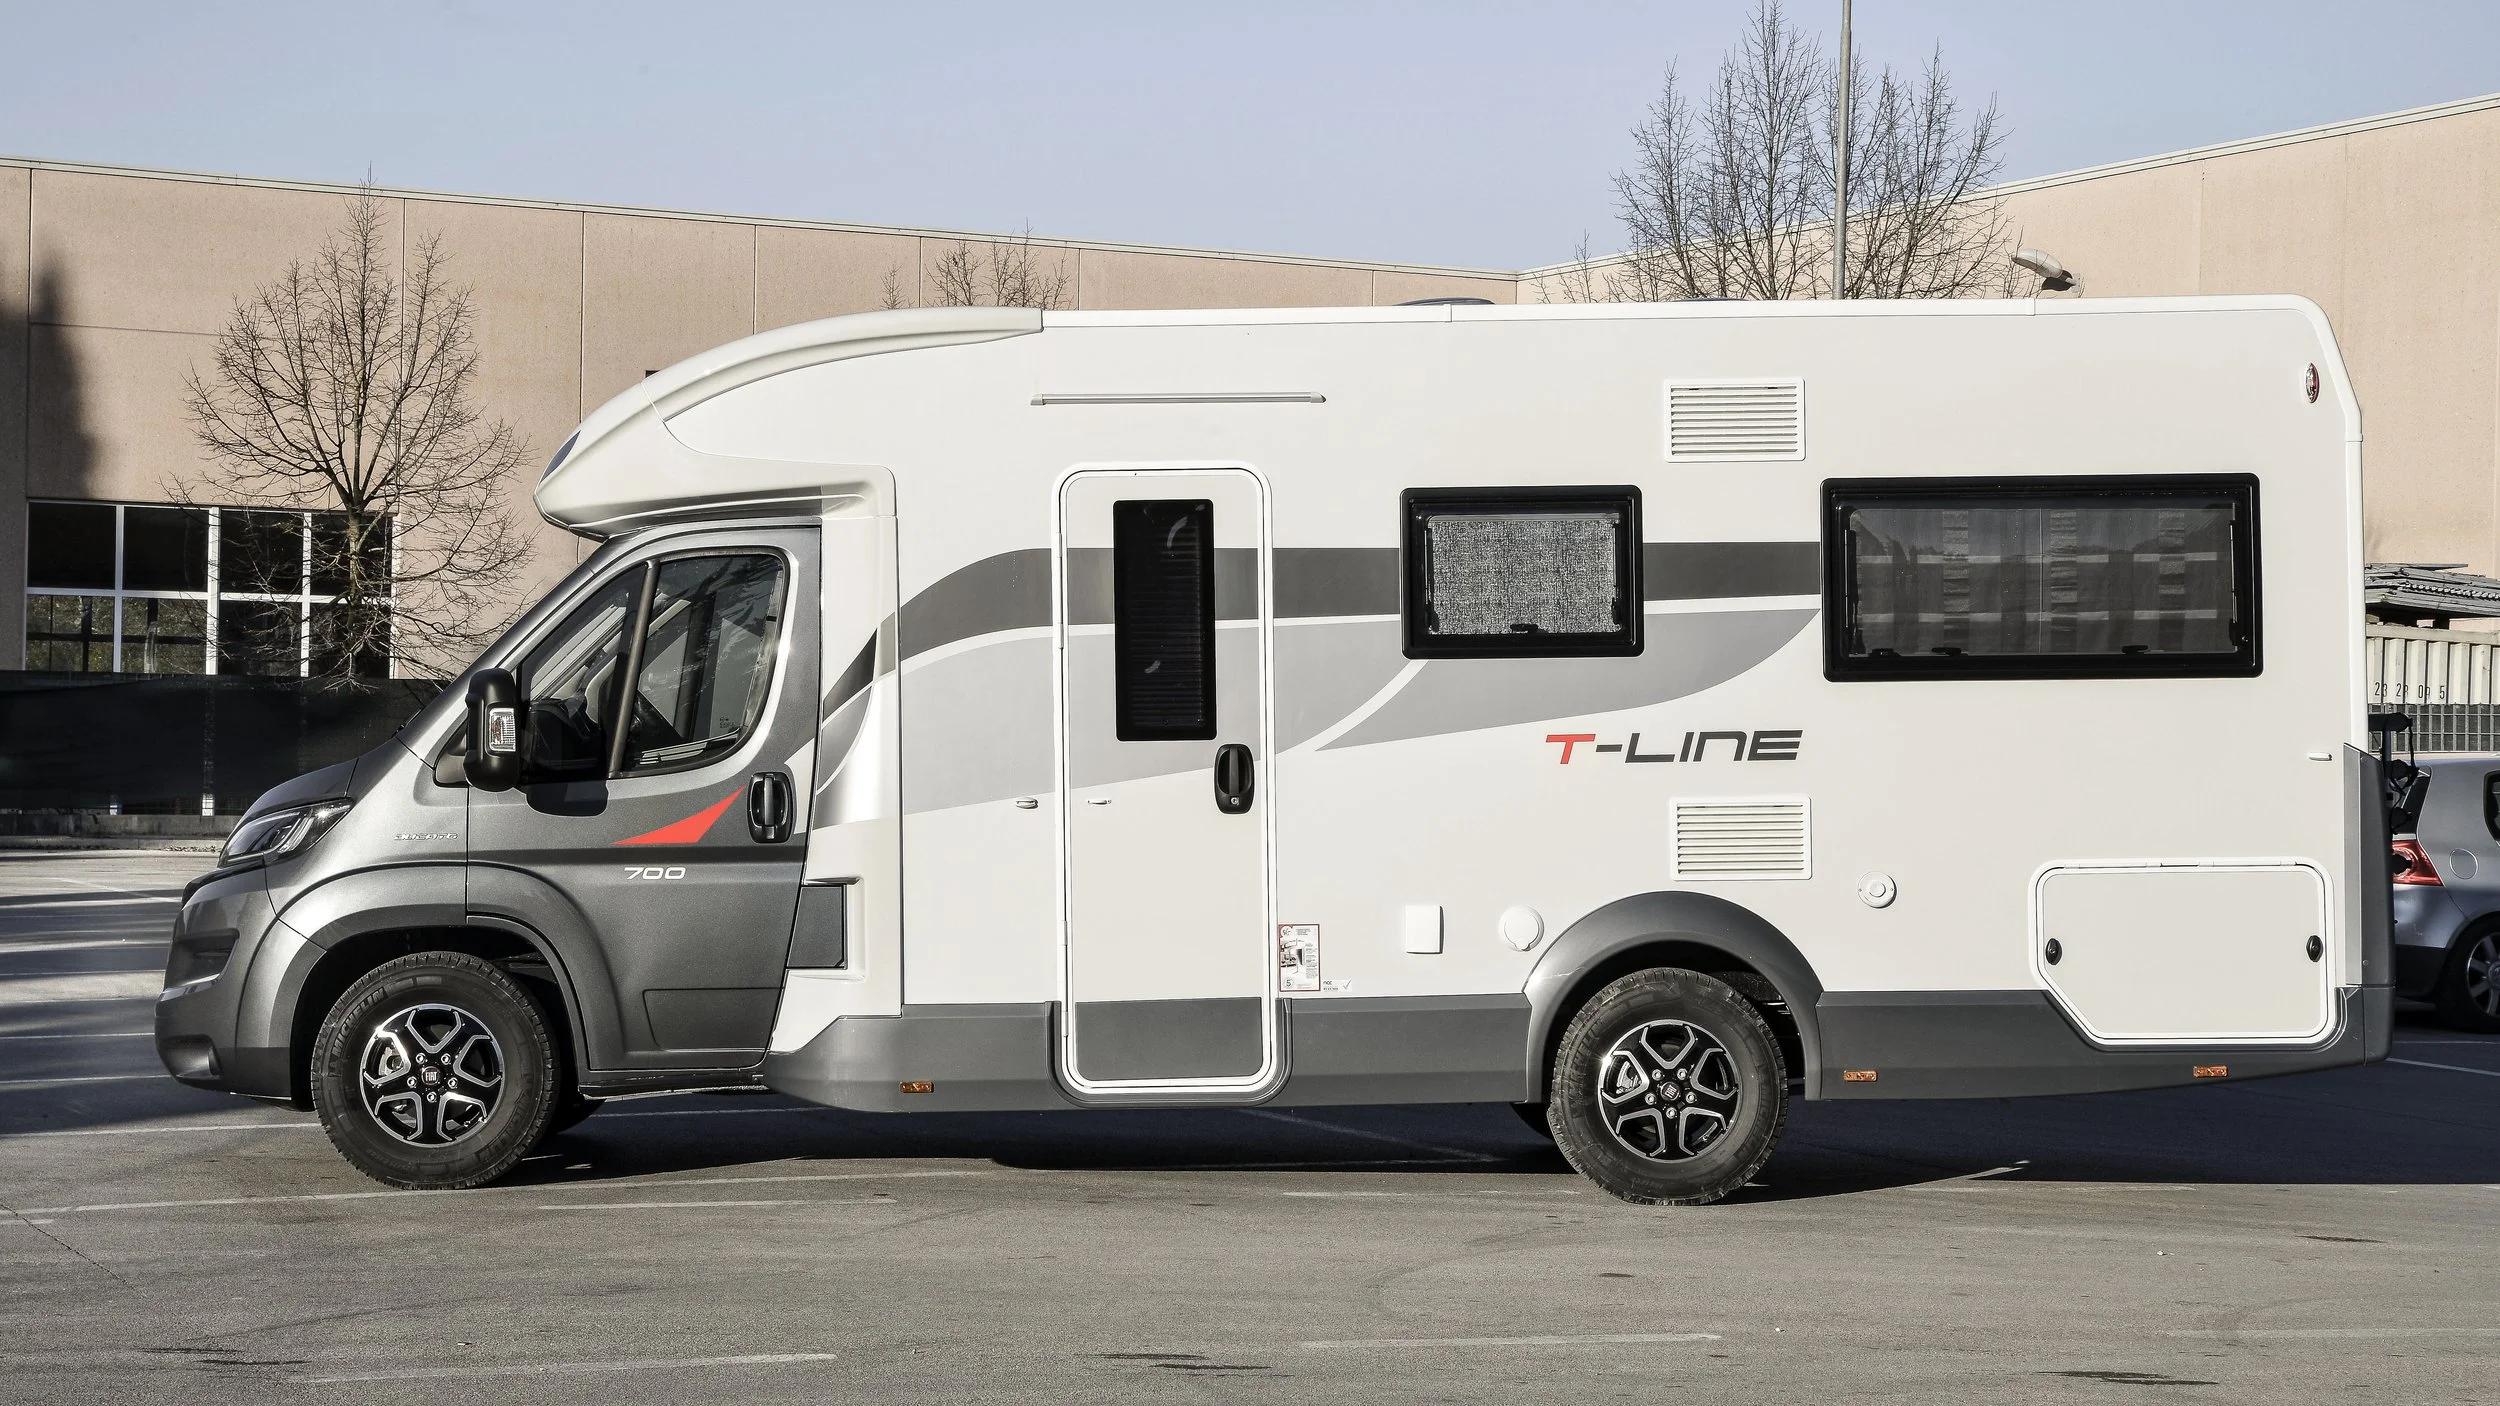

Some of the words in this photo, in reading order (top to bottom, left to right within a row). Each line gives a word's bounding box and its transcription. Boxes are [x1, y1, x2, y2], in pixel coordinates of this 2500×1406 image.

[1545, 729, 1804, 765] T-LINE
[624, 866, 687, 880] 700
[332, 987, 385, 1058] MICHELIN
[425, 1071, 438, 1082] FIAT
